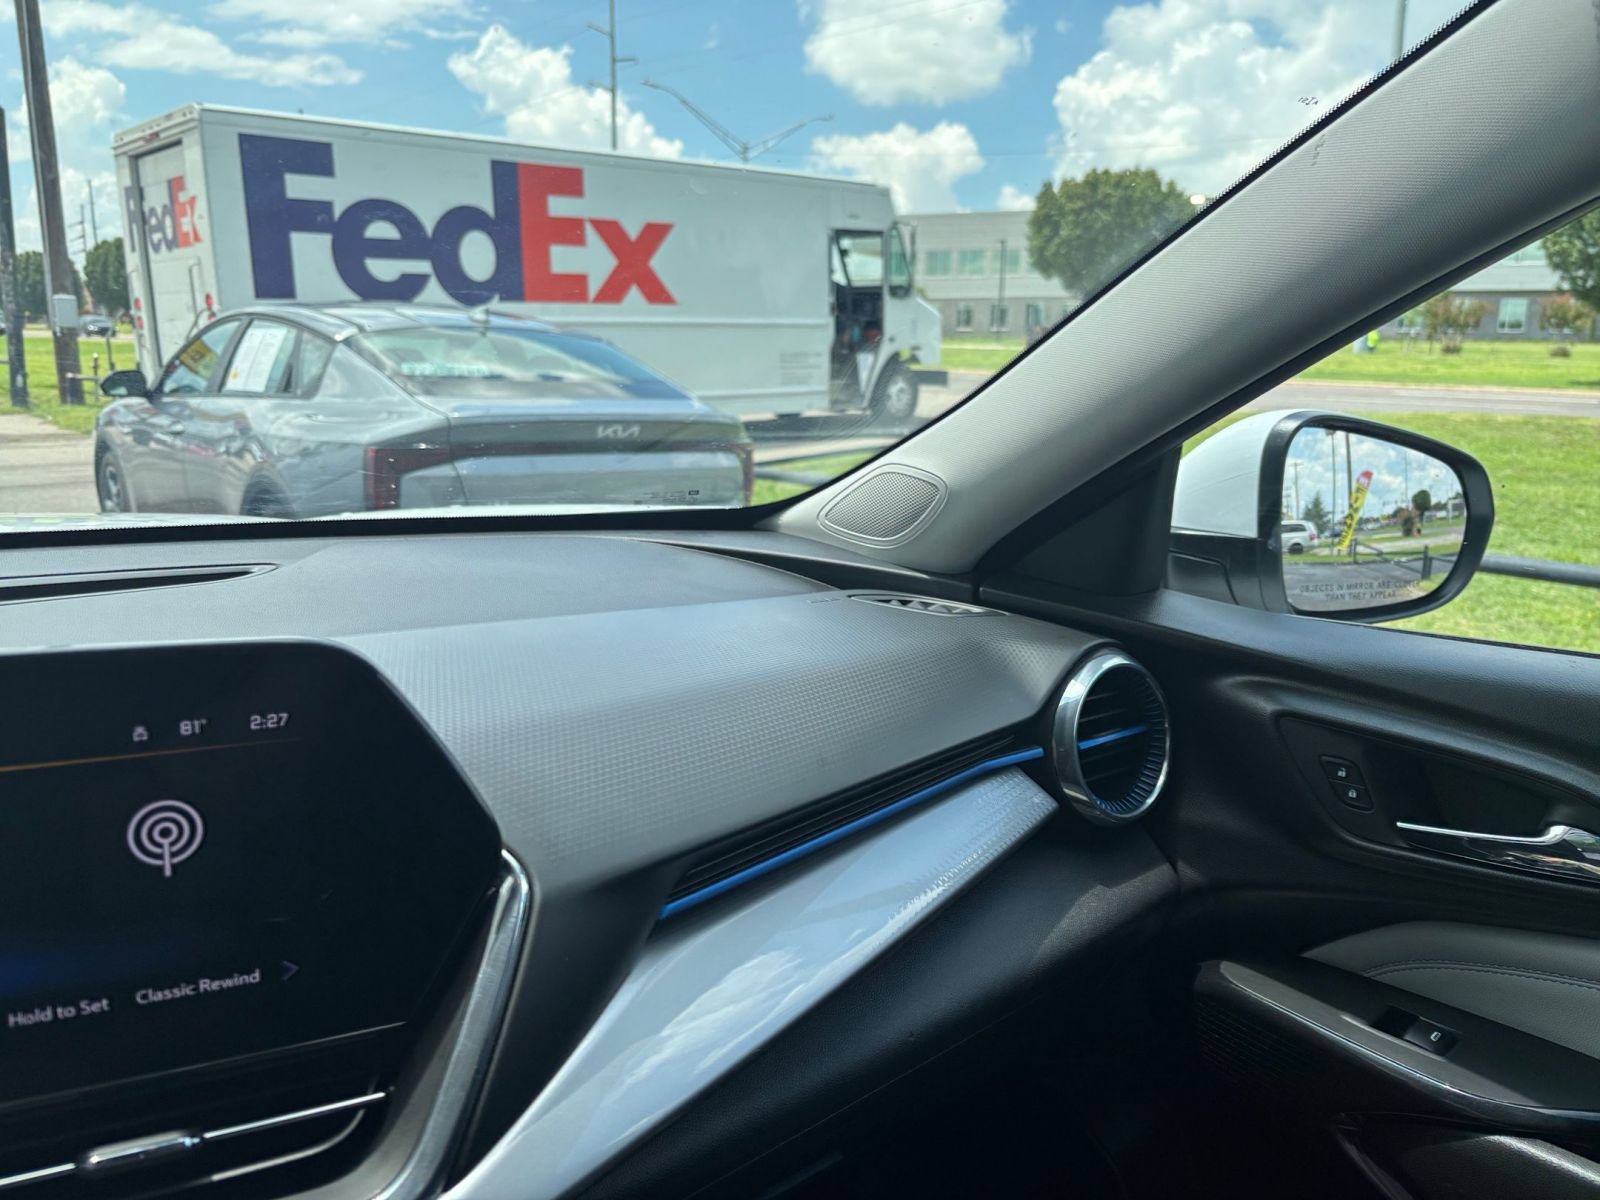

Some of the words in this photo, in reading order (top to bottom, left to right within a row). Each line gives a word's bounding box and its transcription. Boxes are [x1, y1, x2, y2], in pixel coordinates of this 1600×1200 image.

[124, 175, 204, 254] FedEx
[238, 132, 678, 306] FedEx
[597, 424, 640, 438] KIA
[1300, 583, 1334, 593] OBJECTS
[1346, 581, 1374, 591] MIRROR
[249, 712, 289, 731] 2:27
[136, 983, 197, 1005] Classic
[199, 968, 260, 991] Rewind
[8, 1005, 53, 1028] Hold
[57, 1006, 77, 1019] to
[80, 998, 110, 1015] Set
